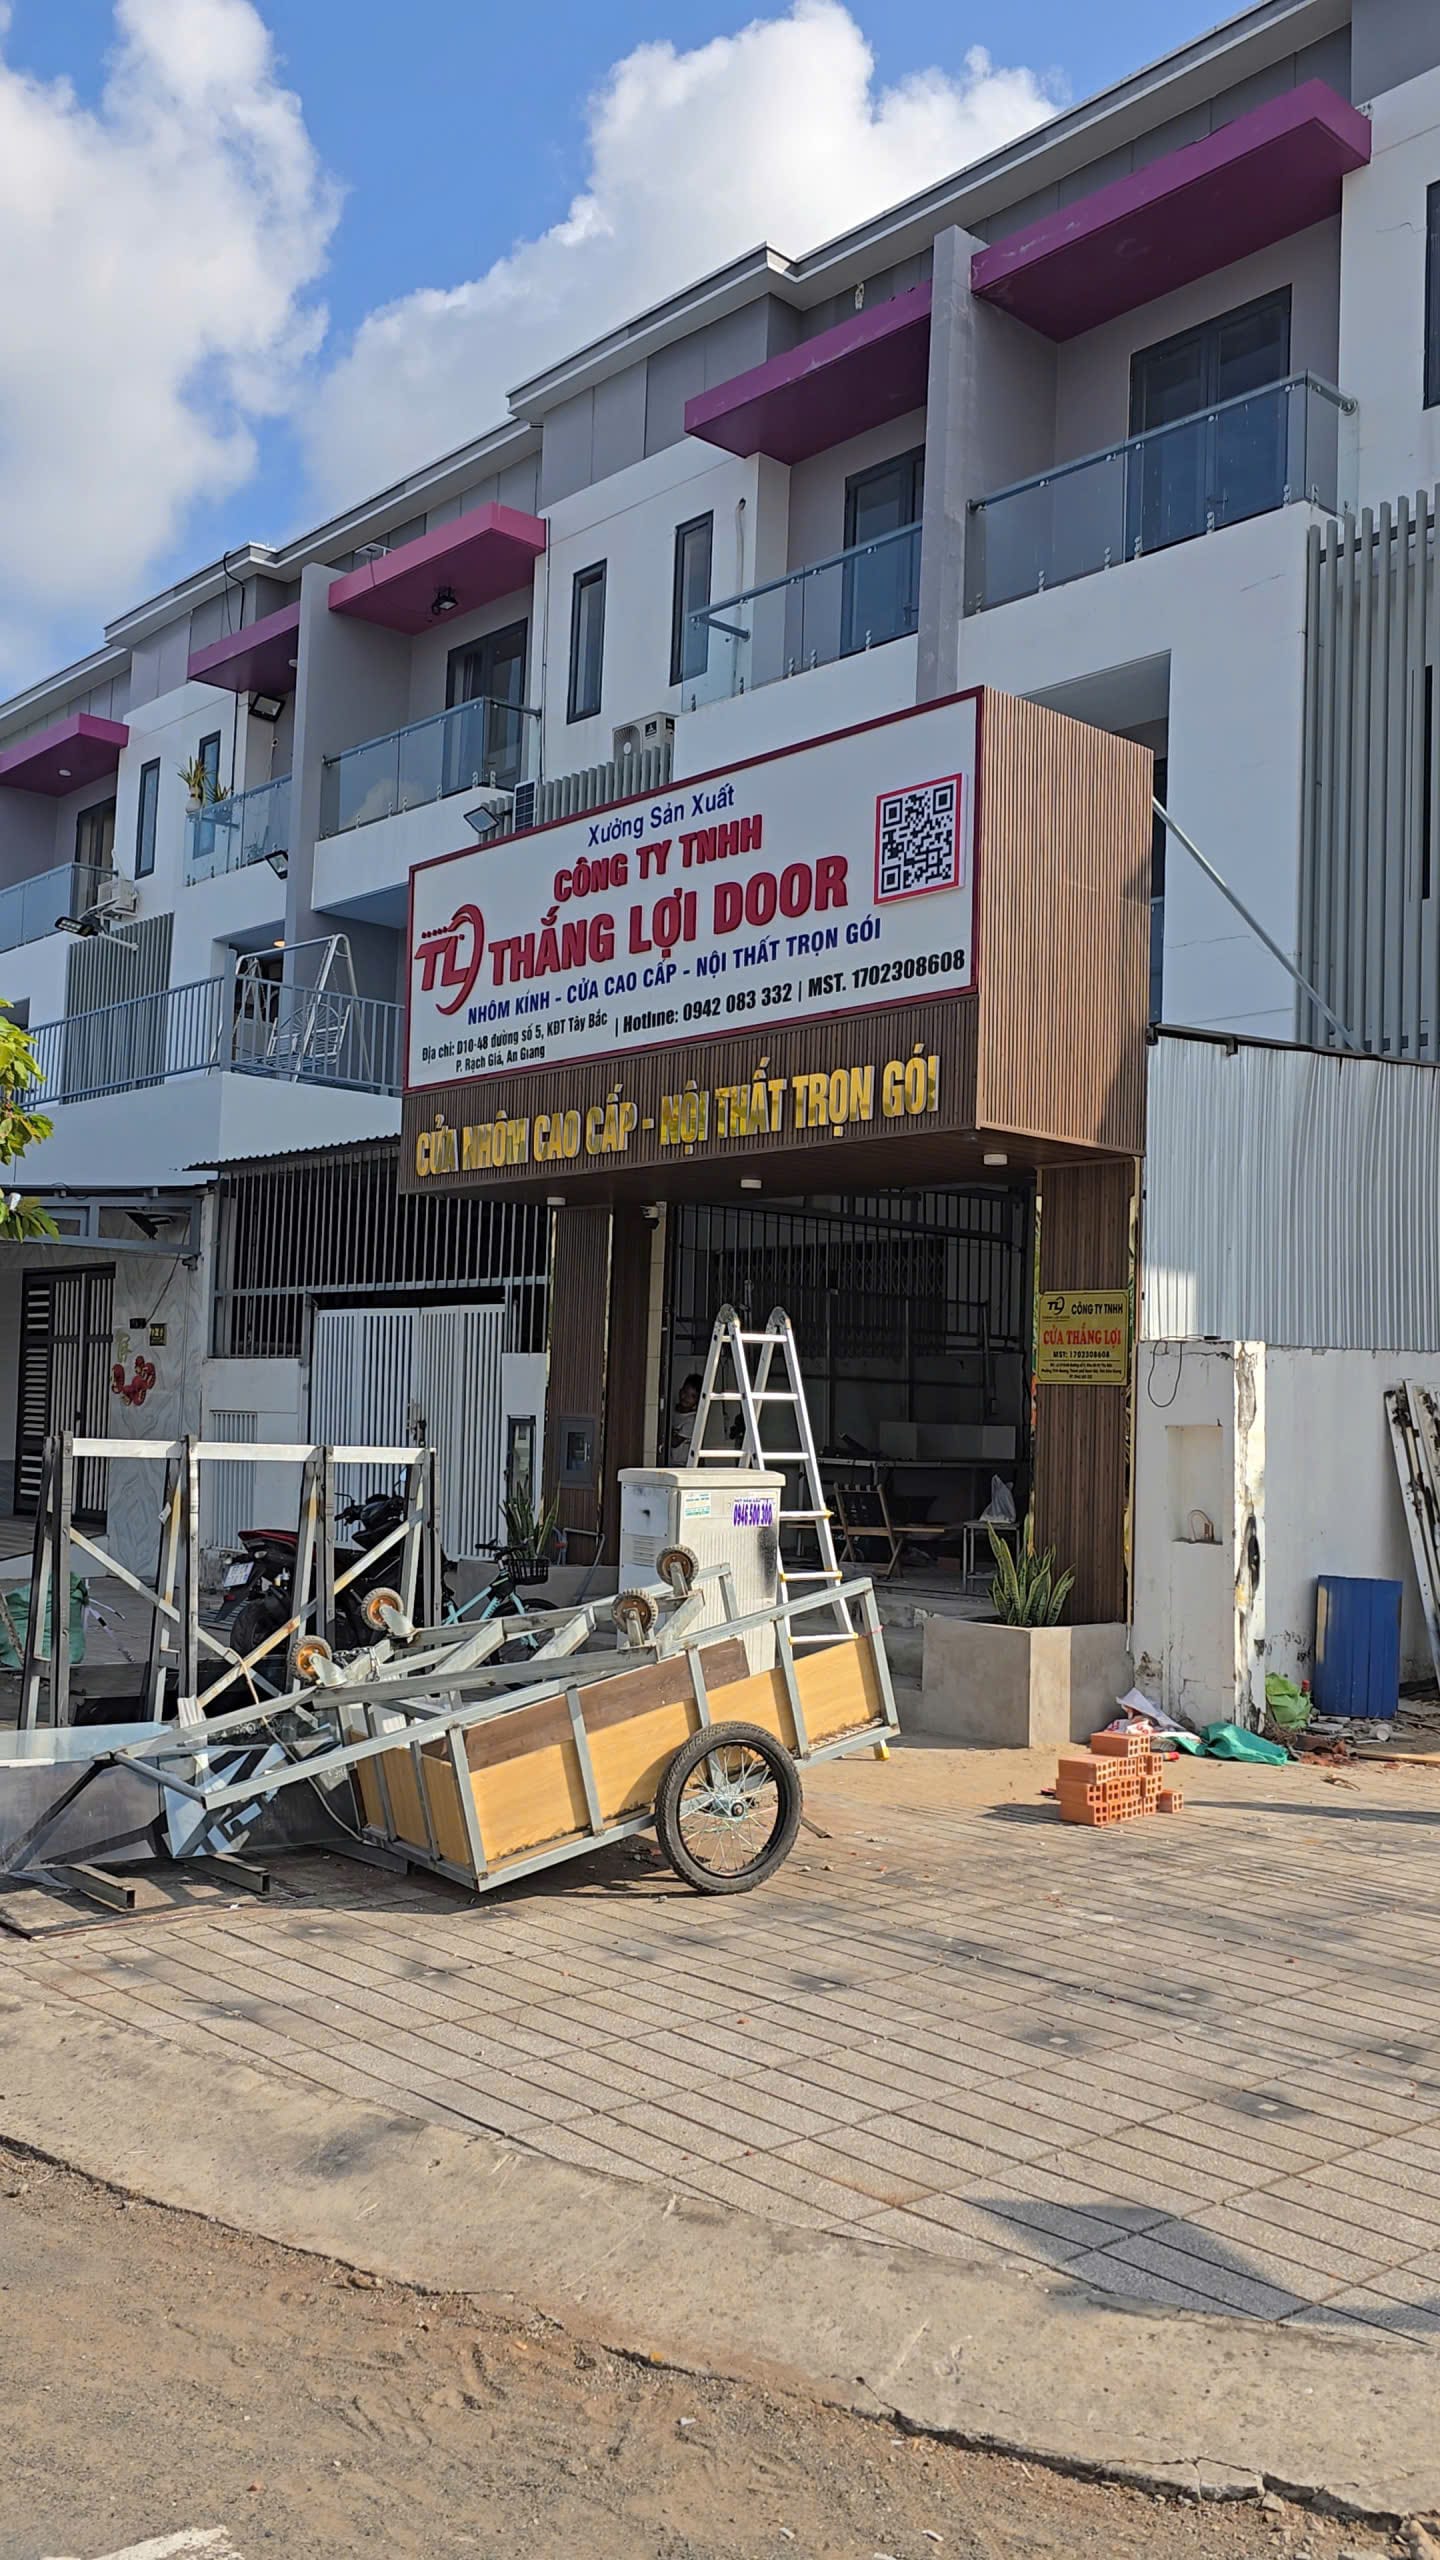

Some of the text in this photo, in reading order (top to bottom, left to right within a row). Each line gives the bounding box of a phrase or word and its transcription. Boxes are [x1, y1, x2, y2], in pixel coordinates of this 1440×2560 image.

[587, 783, 735, 847] Xưởng Sản Xuất
[554, 814, 763, 902] CÔNG TY TNHH
[488, 905, 616, 986] THẮNG
[629, 887, 697, 958] LỢI
[713, 855, 848, 935] DOOR
[468, 1000, 510, 1025] NHÔM
[515, 989, 550, 1015] KÍNH
[567, 977, 599, 1004] CỬA
[604, 971, 637, 996] CAO
[643, 957, 677, 988] CẤP
[697, 949, 727, 980] NỘI
[733, 935, 780, 969] THẤT
[786, 927, 838, 957] TRỌN
[846, 916, 881, 947] GÓI
[623, 1009, 679, 1034] Hotline:
[682, 997, 721, 1023] 0942
[726, 990, 756, 1014] 083
[761, 983, 792, 1007] 332
[808, 973, 847, 998] MST.
[852, 949, 965, 989] 1702308608
[422, 1047, 436, 1064] Địa
[457, 1036, 488, 1055] D10-48
[491, 1028, 519, 1049] đường
[521, 1023, 533, 1043] số
[535, 1024, 545, 1041] 5,
[547, 1018, 567, 1037] KĐT
[569, 1016, 585, 1033] Tây
[588, 1008, 608, 1029] Bắc
[456, 1059, 463, 1073] P.
[465, 1052, 486, 1073] Rạch
[507, 1049, 518, 1063] An
[520, 1045, 546, 1060] Giang
[416, 1113, 459, 1177] CỬA
[462, 1110, 529, 1171] NHÔM
[533, 1109, 581, 1162] CAO
[585, 1083, 638, 1155] CẤP
[659, 1079, 710, 1155] NỘI
[715, 1056, 787, 1139] THẤT
[792, 1065, 875, 1137] TRỌN
[882, 1043, 940, 1118] GÓI
[1043, 1322, 1121, 1349] CỬA THẮNG LỢI
[1071, 1300, 1093, 1315] CÔNG
[1095, 1303, 1104, 1314] TY
[1104, 1303, 1123, 1314] TNHH
